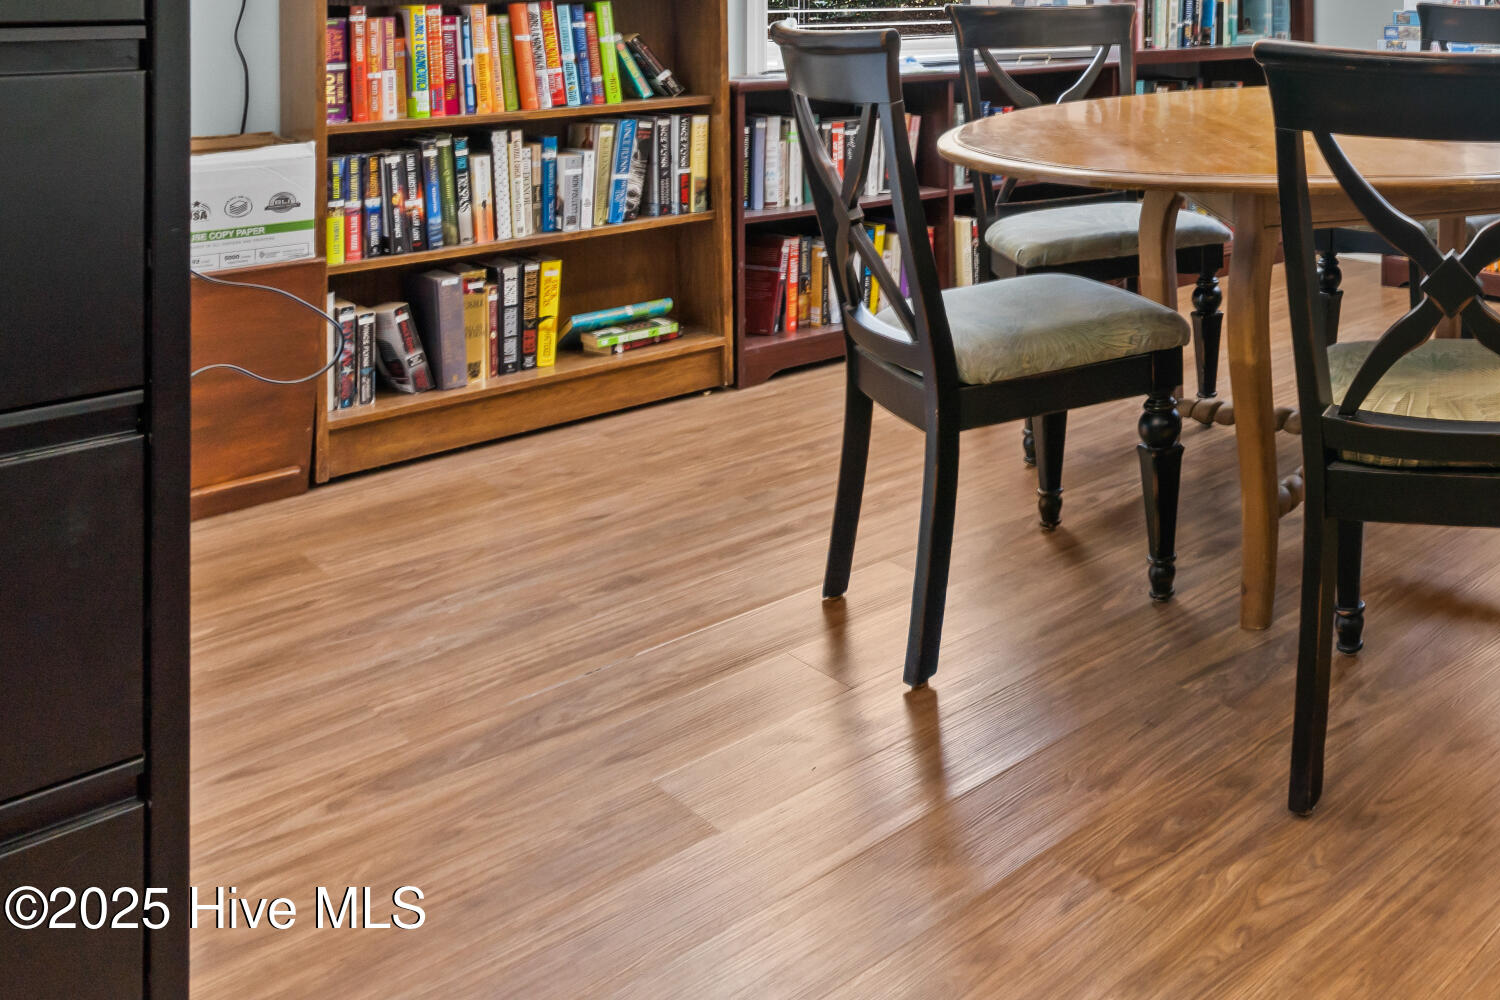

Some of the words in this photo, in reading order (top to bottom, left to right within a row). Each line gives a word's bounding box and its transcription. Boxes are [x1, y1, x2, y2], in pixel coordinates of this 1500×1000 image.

[414, 14, 426, 41] JANET
[680, 118, 690, 142] VINCE
[680, 143, 690, 168] FLYNN
[191, 210, 208, 222] SA
[208, 230, 235, 241] COPY
[236, 226, 265, 237] PAPER
